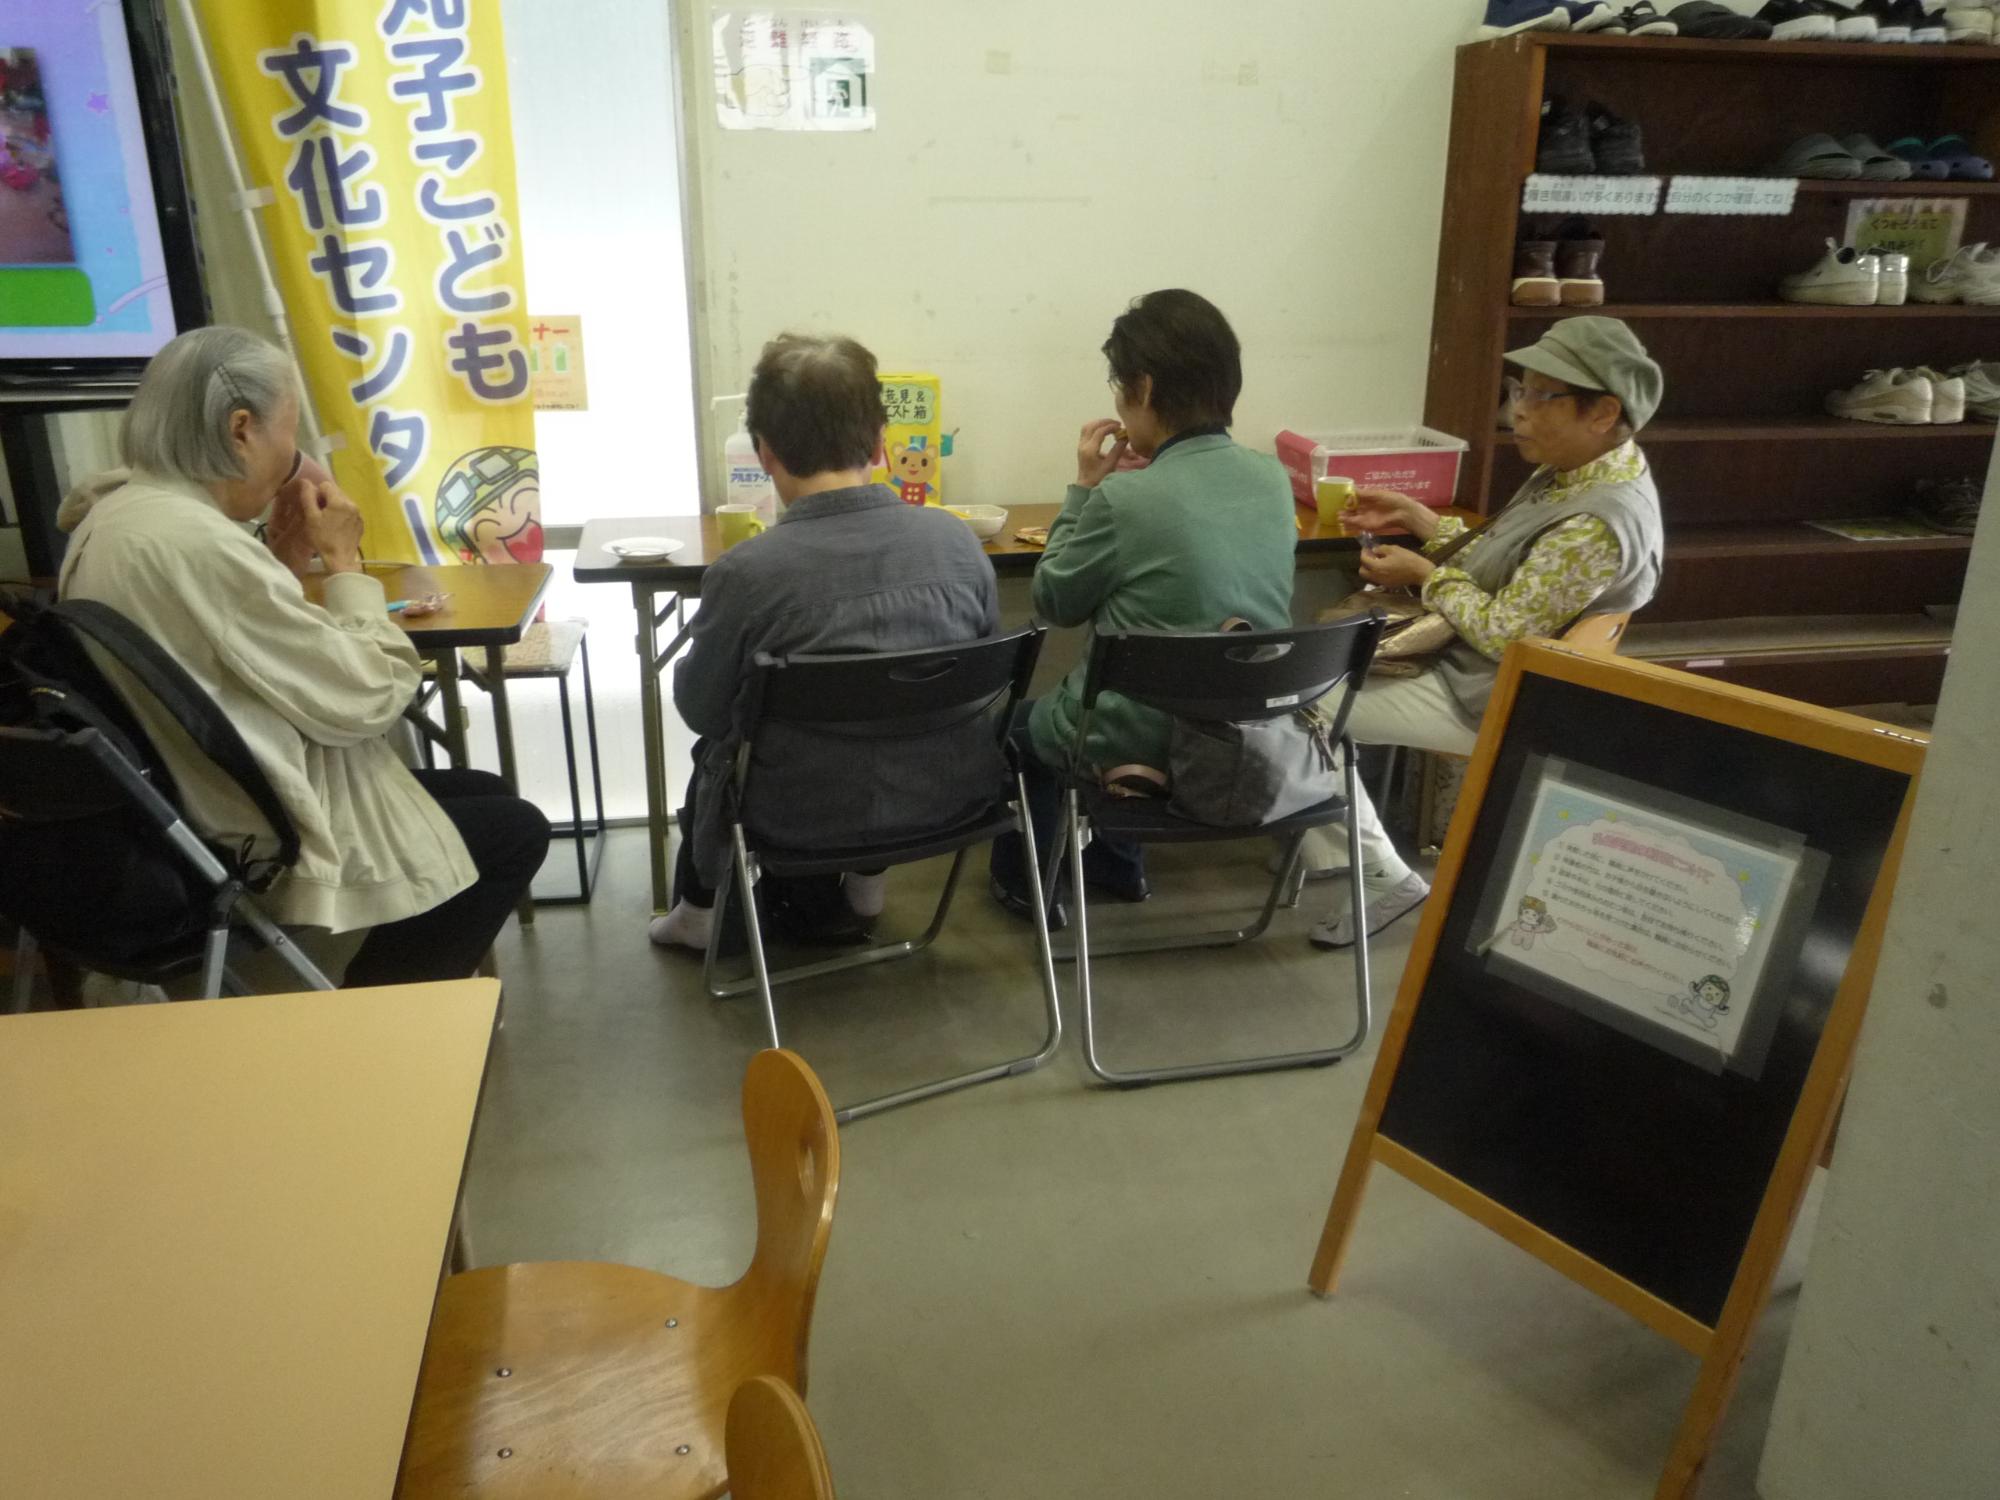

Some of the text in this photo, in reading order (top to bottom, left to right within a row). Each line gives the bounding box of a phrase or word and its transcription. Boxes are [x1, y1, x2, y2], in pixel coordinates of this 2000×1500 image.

[264, 38, 441, 566] 文化センター
